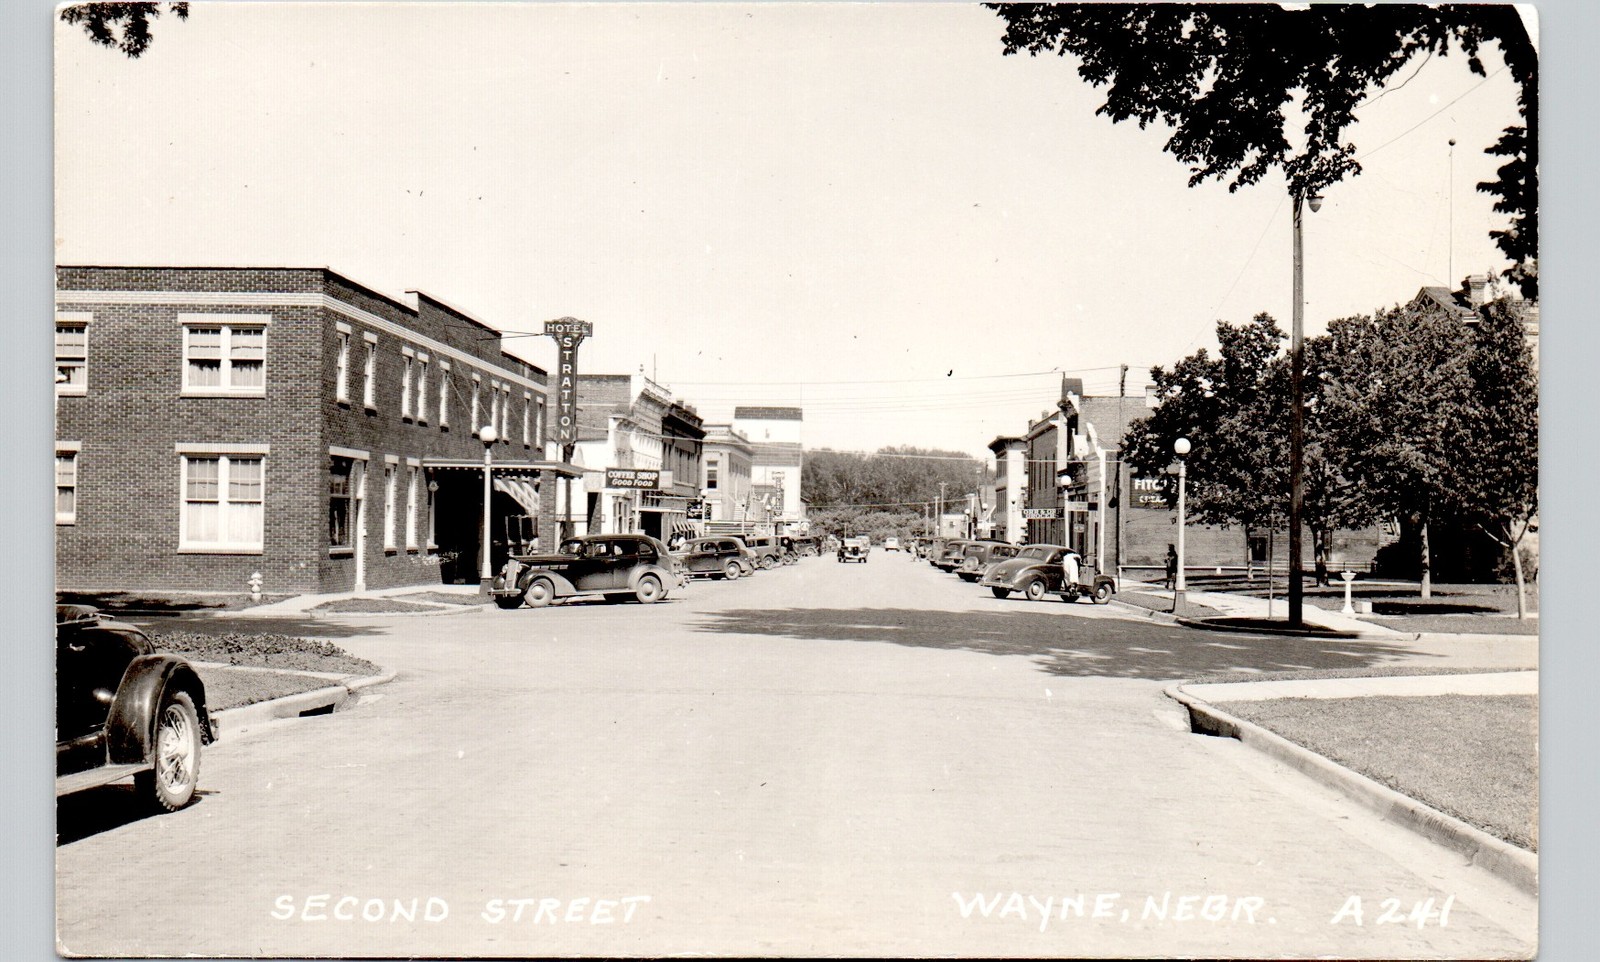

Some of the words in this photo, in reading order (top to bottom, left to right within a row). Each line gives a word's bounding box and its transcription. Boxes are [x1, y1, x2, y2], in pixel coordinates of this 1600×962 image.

[546, 324, 590, 333] HOTEL
[560, 337, 573, 439] STRATTON
[607, 470, 636, 479] COFFEE
[637, 471, 658, 480] SHOP
[612, 478, 633, 486] GOOD
[633, 479, 654, 487] FOOD
